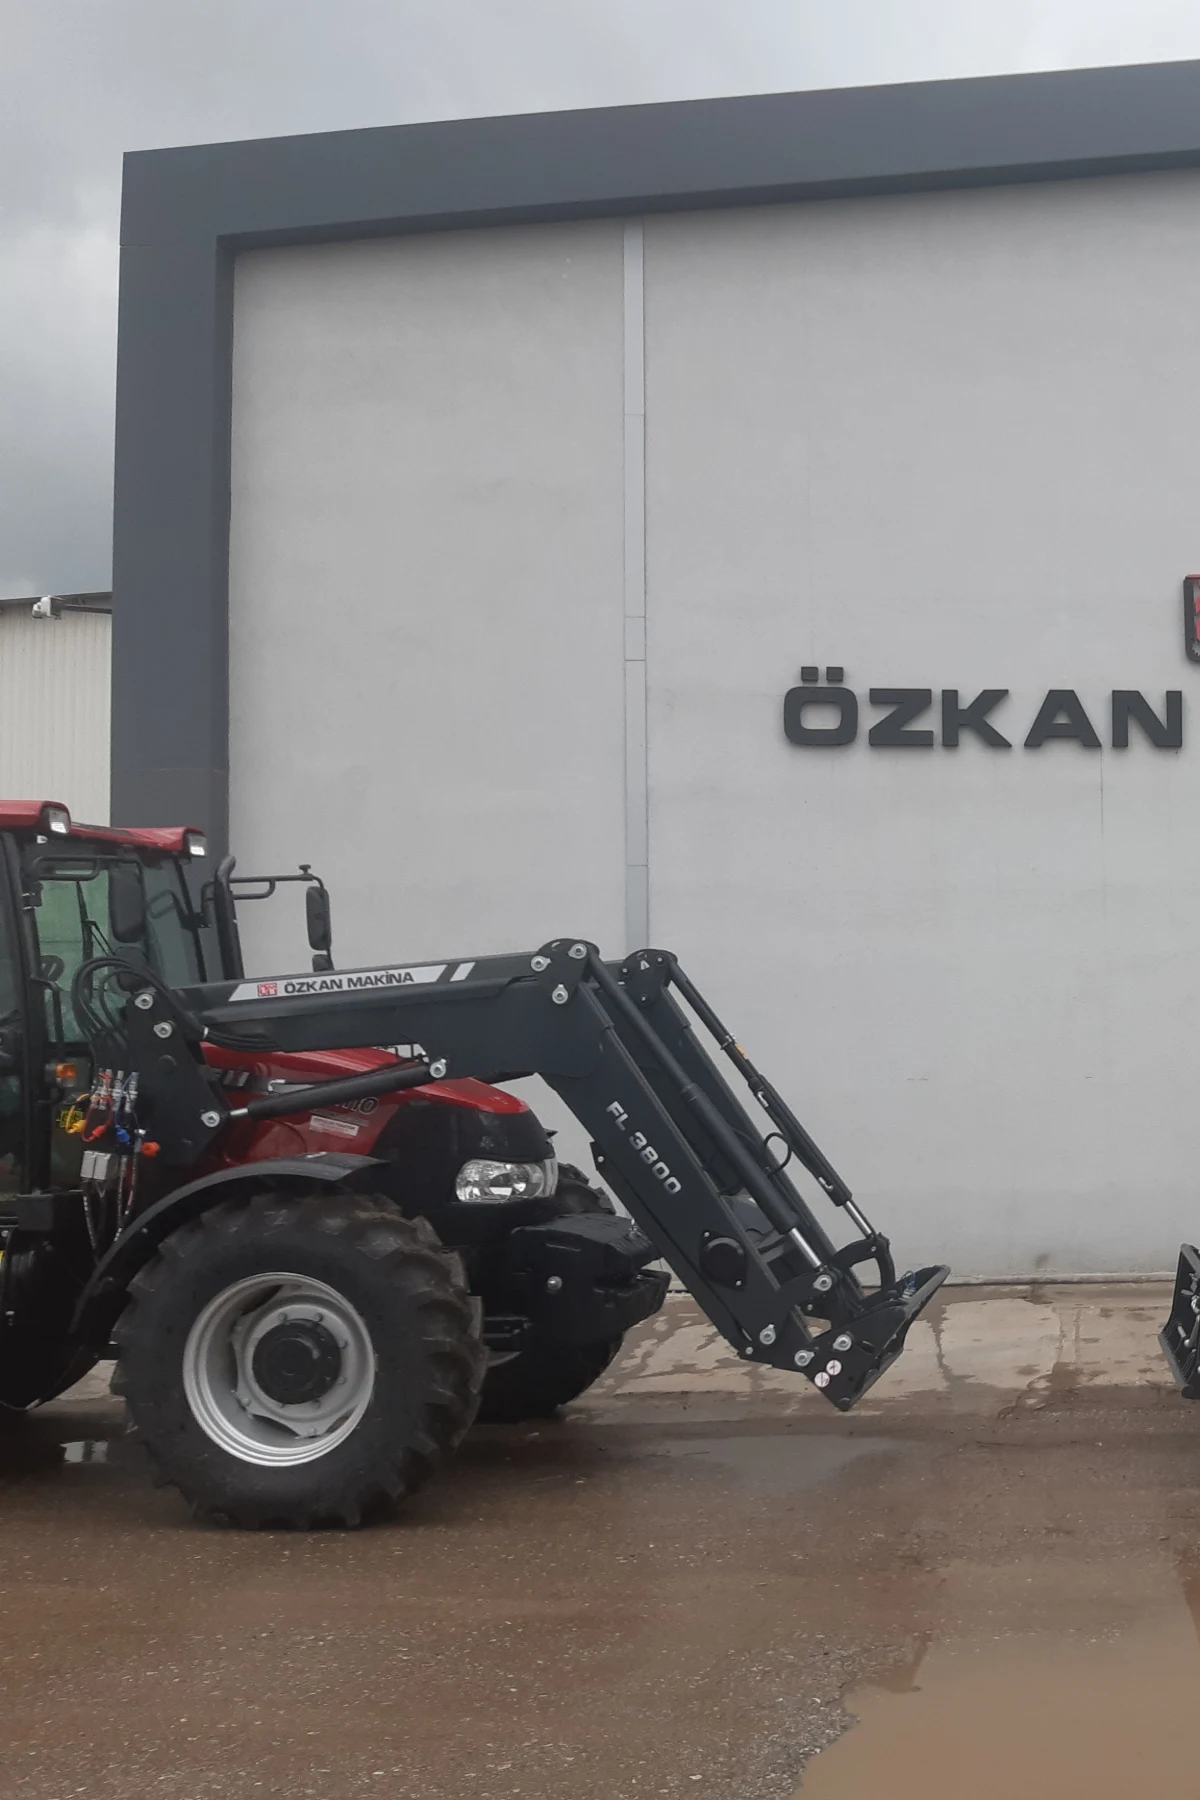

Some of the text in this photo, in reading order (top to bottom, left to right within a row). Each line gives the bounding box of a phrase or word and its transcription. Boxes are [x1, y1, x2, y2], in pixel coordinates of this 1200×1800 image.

[783, 666, 1183, 749] ÖZKAN
[284, 979, 343, 994] ÖZKAN
[347, 971, 414, 989] MAKİNA
[606, 1101, 682, 1195] FL 3800
